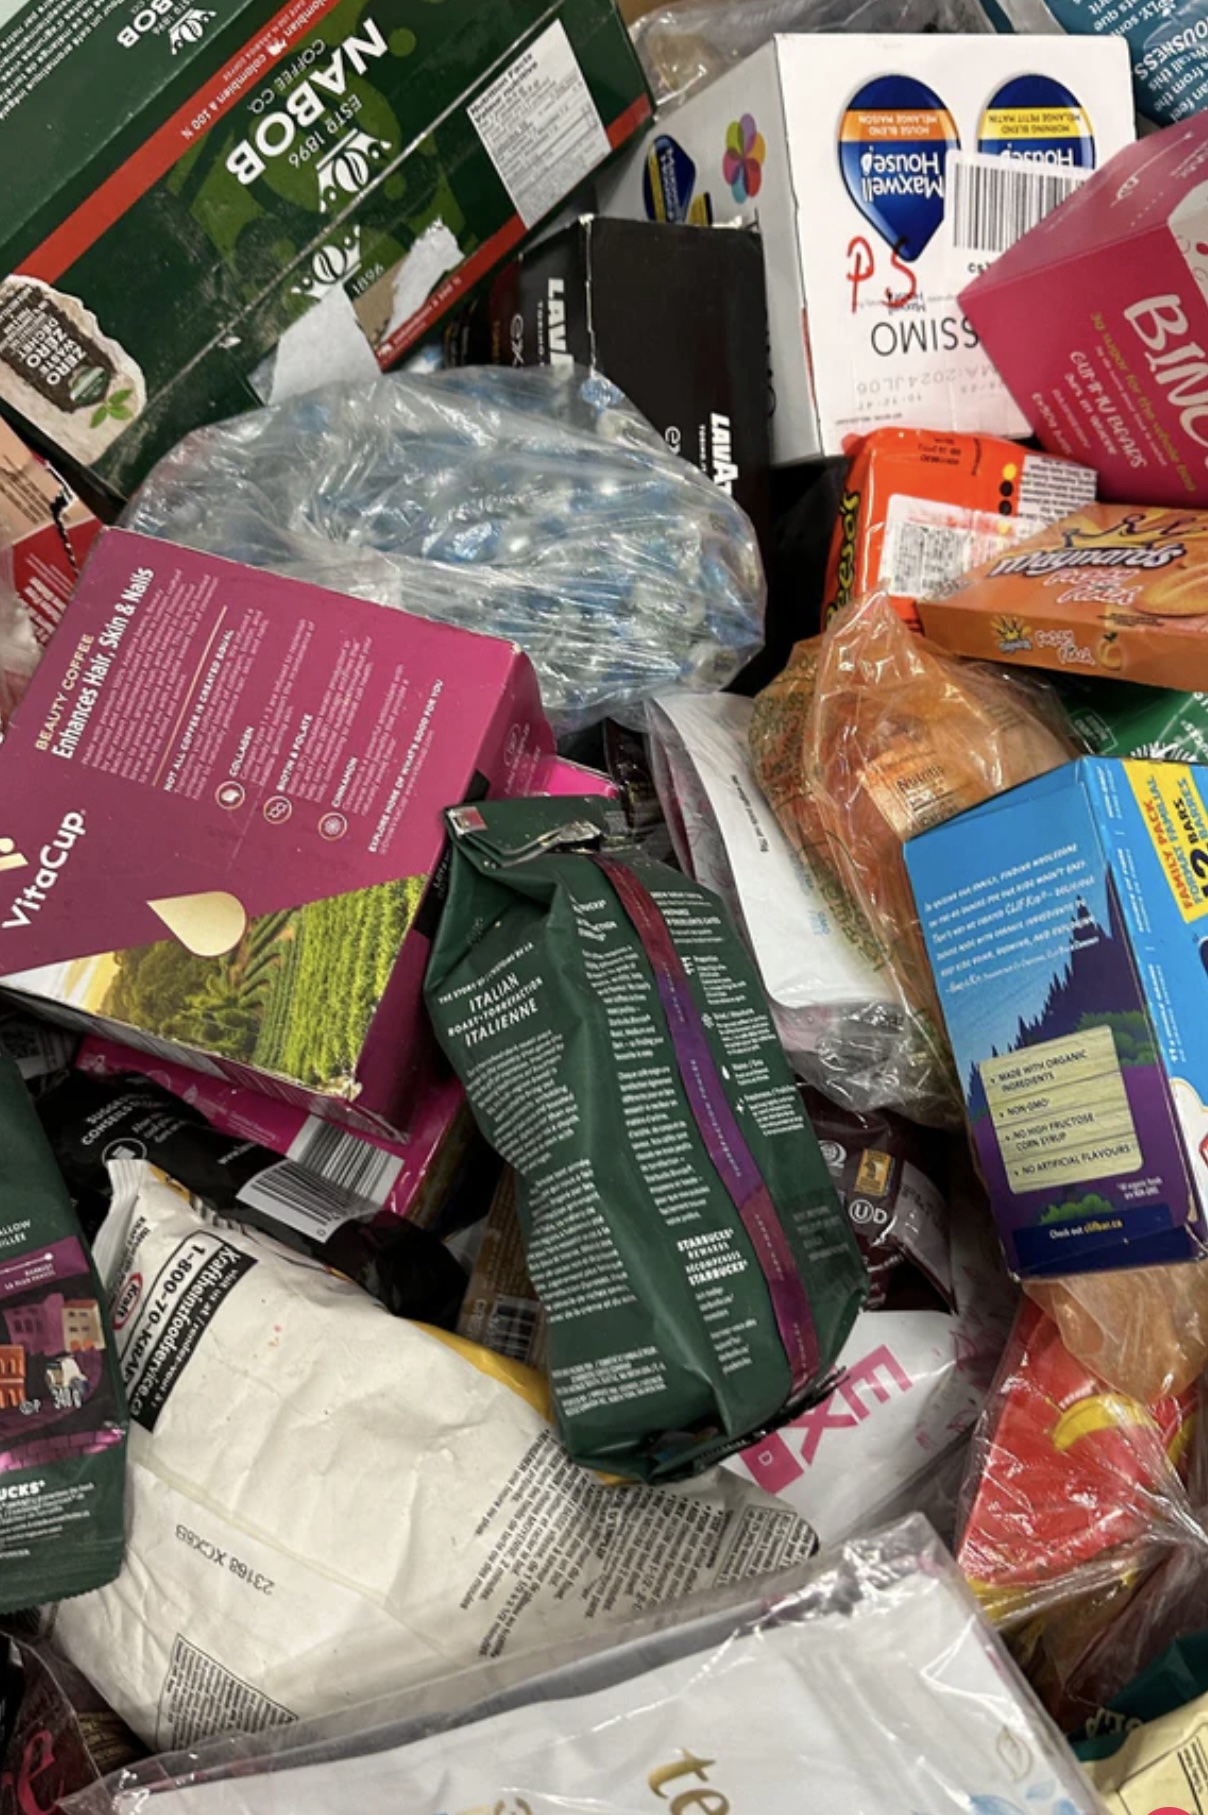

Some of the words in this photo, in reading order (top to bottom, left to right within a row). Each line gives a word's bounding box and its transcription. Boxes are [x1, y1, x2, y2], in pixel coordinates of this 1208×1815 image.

[213, 51, 269, 104] colombien
[270, 36, 329, 92] COFFEE
[1169, 65, 1205, 95] from
[467, 76, 510, 115] Nutrition
[505, 51, 534, 78] Facts
[188, 107, 212, 130] 100
[225, 20, 389, 185] NABOB
[472, 95, 502, 123] Valeur
[857, 114, 892, 125] MAISON
[988, 113, 1015, 124] MATIN
[1018, 113, 1041, 124] PETIT
[866, 125, 897, 136] BLEND
[901, 124, 929, 135] HOUSE
[1001, 124, 1028, 136] BLEND
[1031, 123, 1070, 135] MORNING
[285, 129, 327, 170] 1896
[872, 149, 939, 175] House
[860, 172, 943, 203] Maxwell
[350, 261, 385, 295] 1896
[23, 326, 69, 370] ZERO
[36, 336, 78, 375] WASTE
[42, 344, 89, 388] ZERO
[1123, 372, 1142, 394] for
[1136, 393, 1158, 420] the
[1150, 419, 1183, 465] whole
[1104, 412, 1149, 474] BEARS
[985, 543, 1188, 578] Maynards
[120, 562, 156, 606] Nails
[113, 598, 131, 616] &
[99, 612, 129, 651] Skin
[214, 628, 235, 660] EQUAL
[81, 645, 116, 689] Hair,
[197, 659, 223, 703] CREATED
[34, 691, 70, 752] BEAUTY
[59, 631, 95, 692] COFFEE
[430, 677, 445, 698] YOU
[49, 683, 100, 761] Enhances
[193, 701, 205, 714] IS
[422, 697, 437, 717] FOR
[177, 713, 201, 751] COFFEE
[412, 715, 430, 743] GOOD
[170, 749, 187, 770] ALL
[227, 724, 256, 777] COLLAGEN
[275, 758, 296, 792] BIOTIN
[291, 711, 315, 750] FOLATE
[398, 741, 419, 775] WHAT'S
[161, 769, 178, 792] NOT
[331, 755, 359, 808] CINNAMON
[393, 774, 406, 788] OF
[383, 787, 401, 813] MORE
[1142, 774, 1180, 843] FAMILIAL
[1175, 776, 1208, 840] BARRES
[367, 812, 391, 853] EXPLORE
[1141, 799, 1169, 846] PACK
[1171, 796, 1199, 845] BARS
[2, 812, 86, 928] VitaCup
[1160, 847, 1195, 909] FAMILY
[1171, 844, 1204, 905] FORMAT
[437, 991, 454, 1006] THE
[451, 980, 478, 1000] STORY
[466, 972, 519, 1012] ITALIAN
[460, 996, 541, 1048] ITALIENNE
[997, 1068, 1021, 1082] MADE
[1022, 1061, 1045, 1076] WITH
[1044, 1048, 1088, 1070] ORGANIC
[1000, 1070, 1055, 1093] INGREDIENTS
[1012, 1128, 1026, 1140] NO
[1025, 1123, 1049, 1137] HIGH
[1048, 1110, 1095, 1132] FRUCTOSE
[1015, 1137, 1039, 1152] CORN
[1040, 1130, 1067, 1146] SYRUP
[1020, 1163, 1035, 1175] NO
[1035, 1153, 1081, 1174] ARTIFICIAL
[1080, 1140, 1131, 1164] FLAVOURS
[1048, 1226, 1069, 1240] Check
[1070, 1225, 1083, 1236] out
[1082, 1216, 1123, 1234] clifbar.ca
[686, 1240, 730, 1259] REWARDS
[208, 1286, 223, 1302] us
[217, 1267, 240, 1288] visit
[114, 1281, 141, 1318] Kraft
[199, 1301, 212, 1316] at
[158, 1322, 202, 1393] rendez-vous
